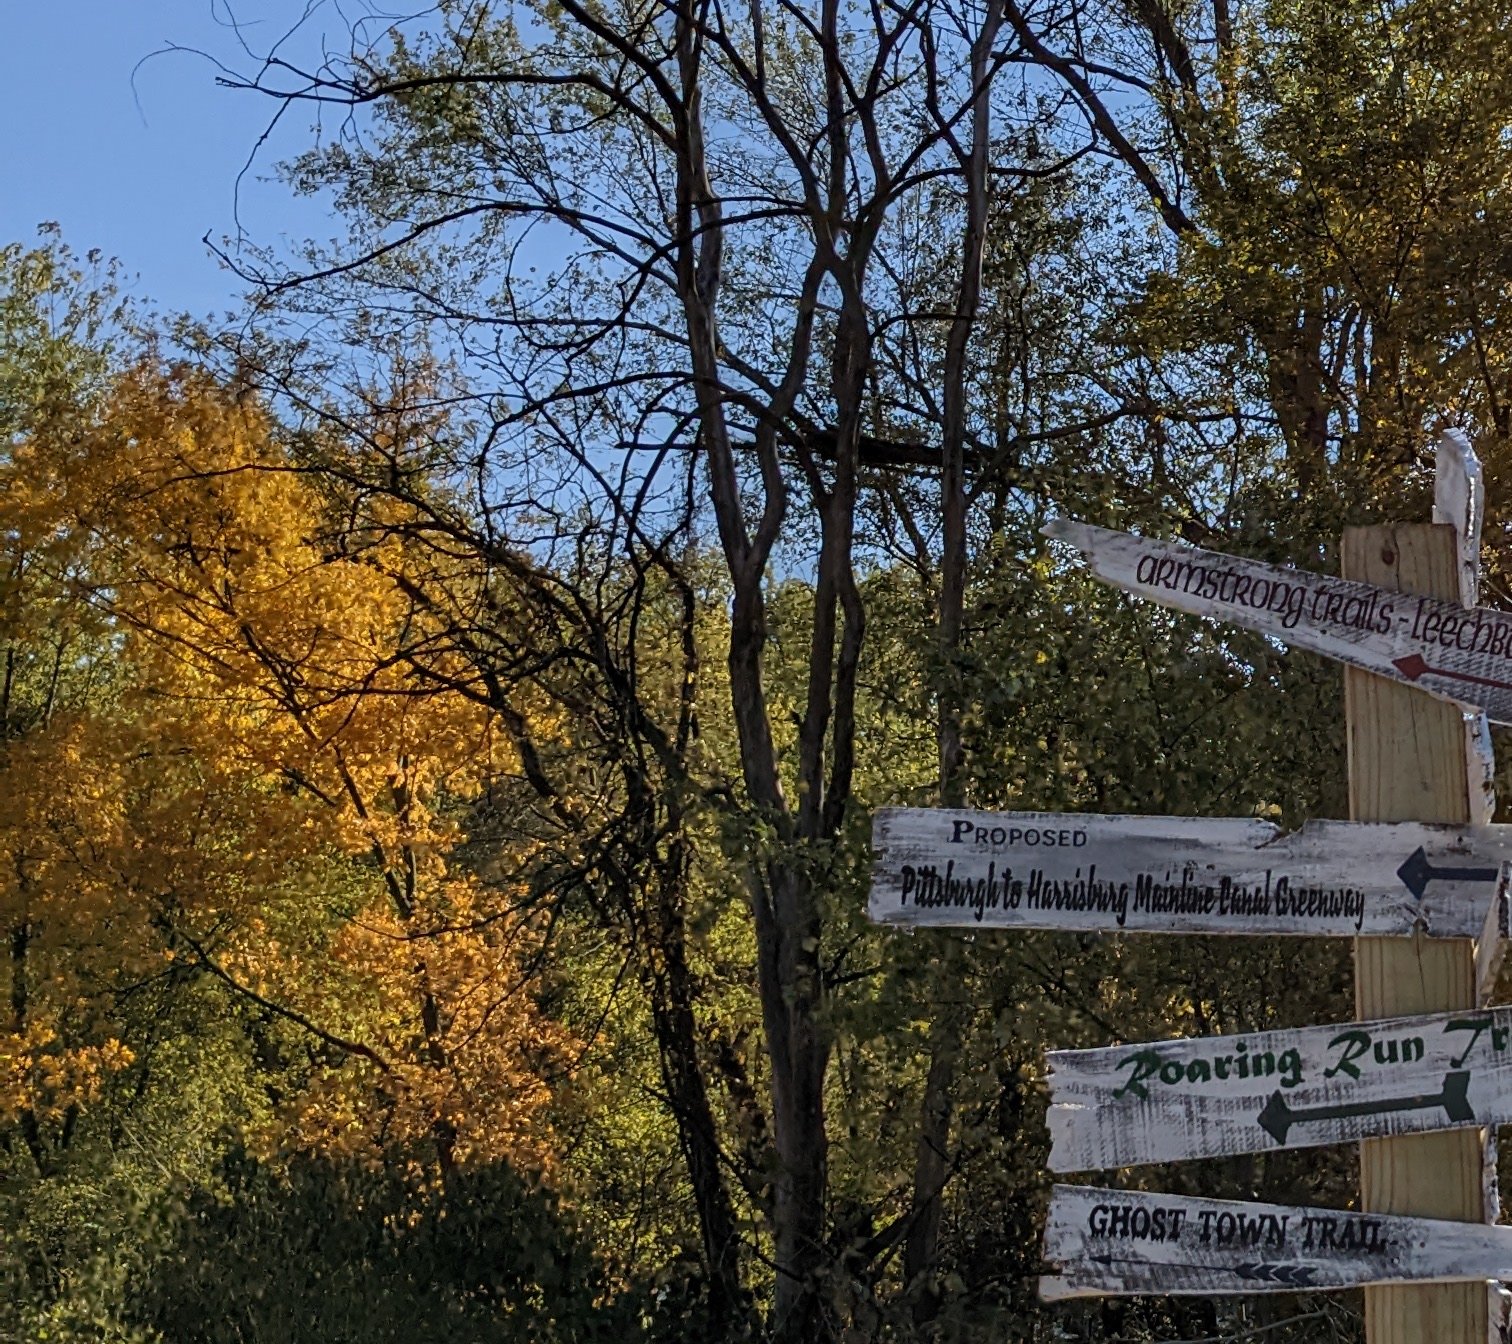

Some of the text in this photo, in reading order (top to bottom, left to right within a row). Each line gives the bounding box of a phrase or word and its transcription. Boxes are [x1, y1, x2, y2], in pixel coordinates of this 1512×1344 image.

[949, 819, 1088, 848] PROPOSED
[901, 859, 1365, 931] Pittsburgh to Harrisburg Mainline Canal Greenway
[1112, 1042, 1303, 1100] Roaring
[1324, 1030, 1424, 1080] Run
[1089, 1204, 1391, 1254] GHOST TOWN TRAIL
